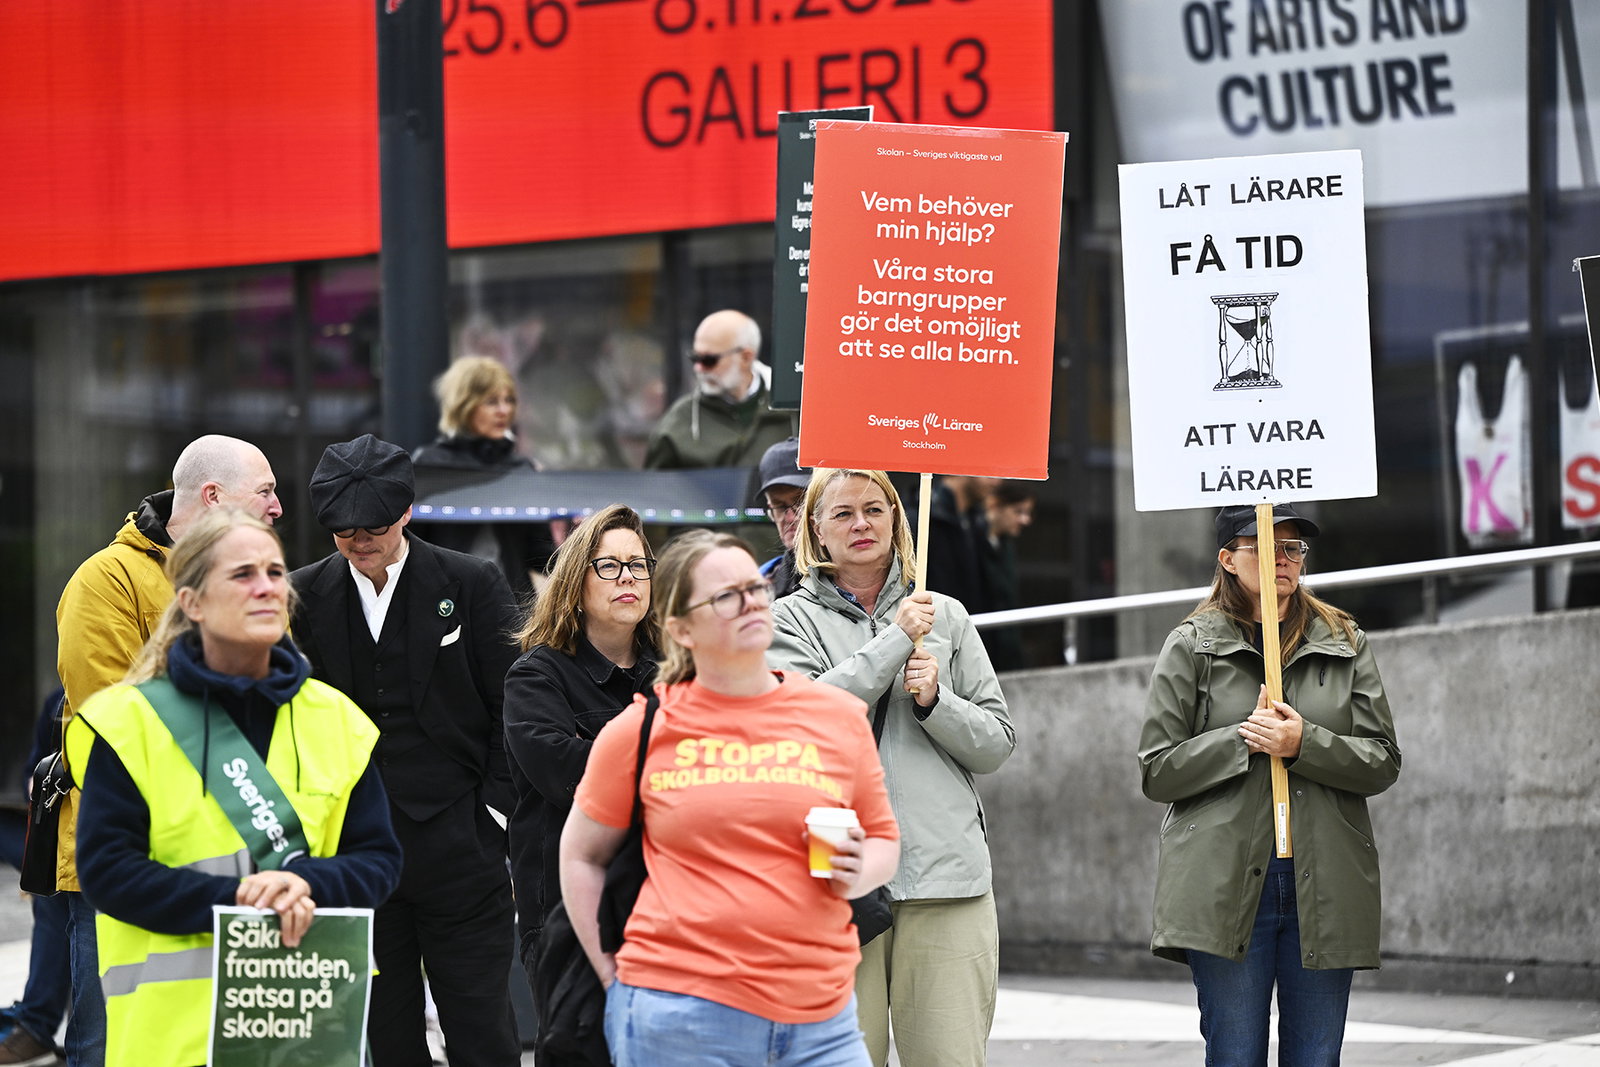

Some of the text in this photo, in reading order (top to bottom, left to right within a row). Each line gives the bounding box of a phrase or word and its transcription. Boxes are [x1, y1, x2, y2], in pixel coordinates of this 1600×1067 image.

[1182, 0, 1467, 63] OF ARTS AND
[641, 37, 989, 149] GALLERI 3
[1217, 53, 1456, 137] CULTURE
[876, 147, 905, 157] Skolan
[912, 149, 948, 160] Sveriges
[948, 151, 989, 162] viktigaste
[989, 153, 1003, 162] val
[860, 190, 1014, 218] Vem behöver
[1158, 174, 1343, 209] LÅT LÄRARE
[875, 218, 995, 247] min hjälp?
[1169, 233, 1303, 276] FÅ TID
[872, 257, 994, 285] Våra stora
[857, 287, 1008, 314] barngrupper
[840, 310, 1021, 344] gör det omöjligt
[838, 338, 1019, 365] att se alla barn.
[867, 414, 984, 432] Sveriges Lärare
[1184, 419, 1325, 448] ATT VARA
[902, 439, 946, 450] Stockholm
[1200, 465, 1313, 493] LÄRARE
[1464, 453, 1518, 533] K
[1562, 455, 1600, 520] S
[674, 737, 826, 772] STOPPA
[222, 757, 290, 853] Sveriges
[226, 920, 281, 949] Säkr
[224, 949, 357, 985] framtiden,
[224, 977, 333, 1016] satsa på
[222, 1009, 313, 1039] skolan!
